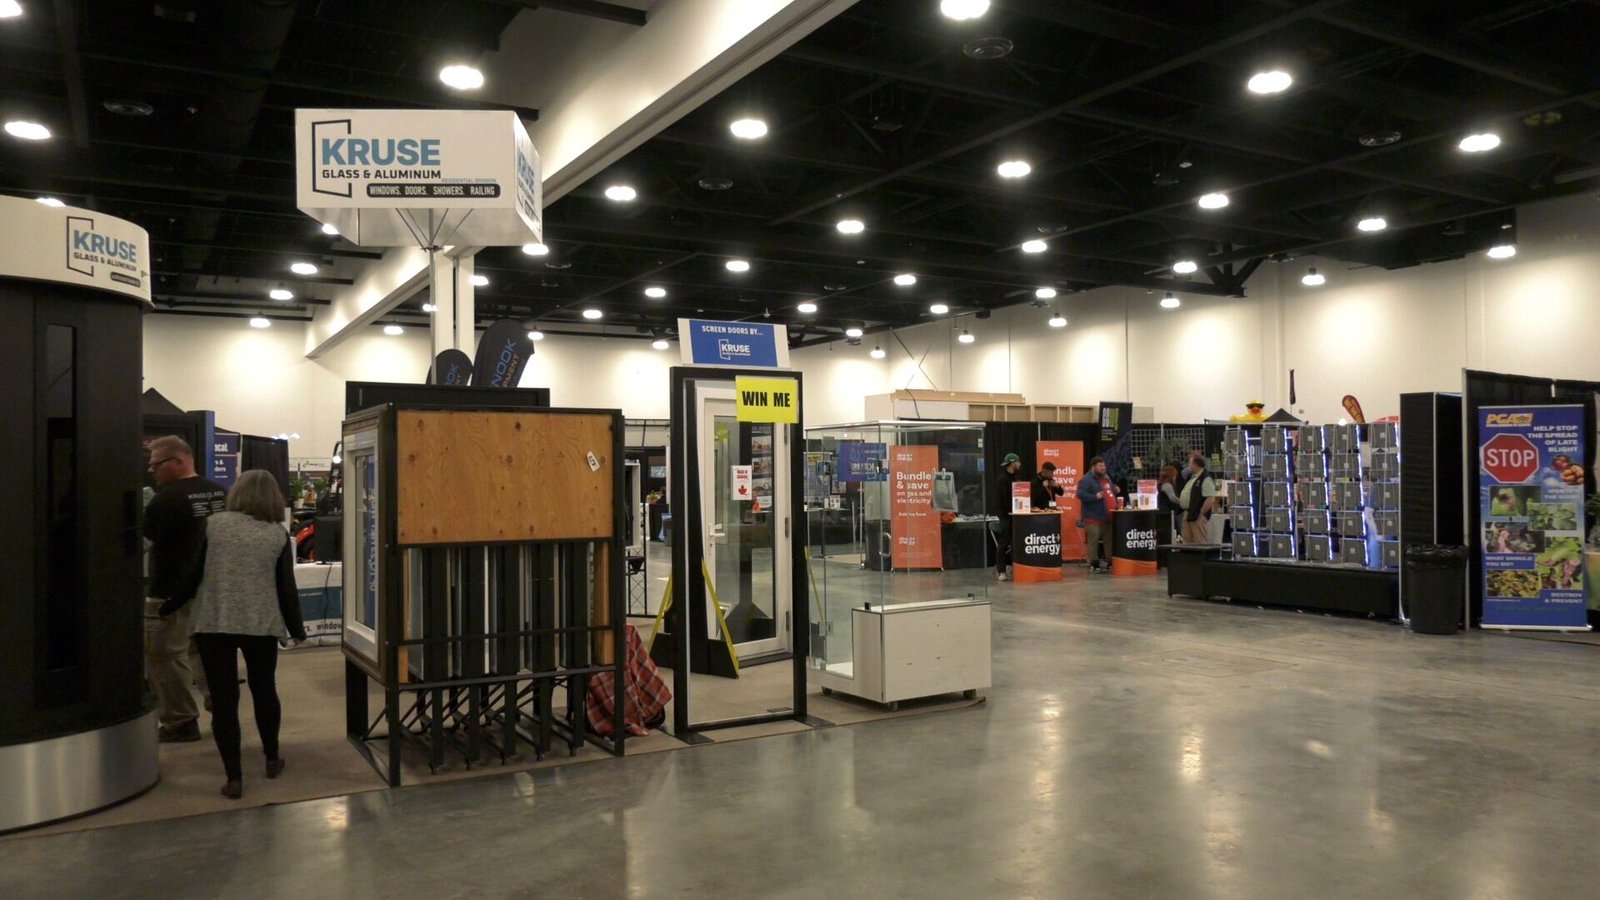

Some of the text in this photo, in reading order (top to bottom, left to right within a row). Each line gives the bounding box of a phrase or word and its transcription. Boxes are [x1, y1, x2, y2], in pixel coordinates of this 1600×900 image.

[322, 138, 441, 166] KRUSE
[322, 169, 442, 179] GLASS & ALUMINUM
[470, 185, 496, 196] RAILING
[73, 229, 137, 264] KRUSE
[73, 251, 99, 262] GLASS
[701, 325, 727, 333] SCREEN
[728, 326, 749, 335] DOORS
[721, 343, 751, 353] KRUSE
[741, 390, 791, 407] WIN ME
[1486, 448, 1535, 468] STOP
[896, 471, 932, 480] Bundle
[1053, 466, 1077, 475] ndle
[896, 481, 929, 490] & save
[1024, 533, 1056, 545] direct
[1126, 529, 1154, 540] direct
[1024, 544, 1061, 556] energy
[1126, 539, 1157, 550] energy
